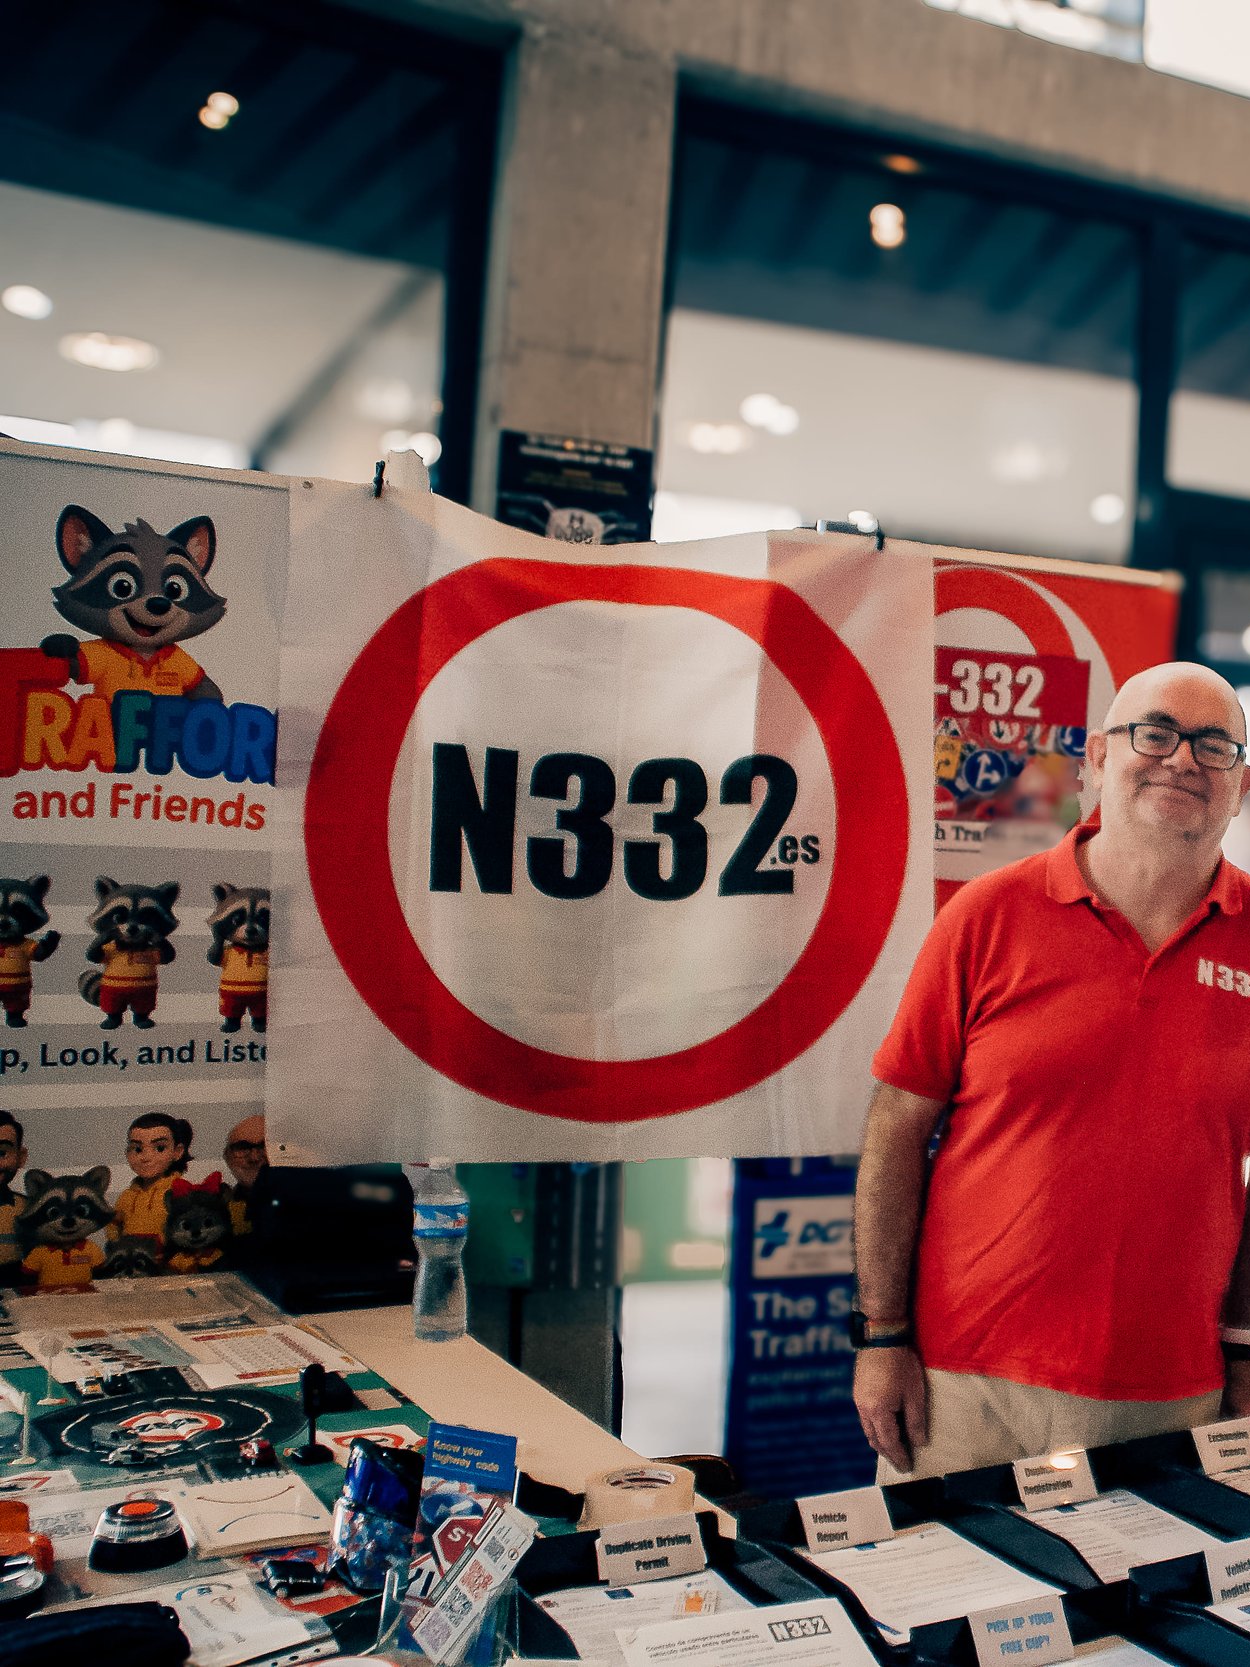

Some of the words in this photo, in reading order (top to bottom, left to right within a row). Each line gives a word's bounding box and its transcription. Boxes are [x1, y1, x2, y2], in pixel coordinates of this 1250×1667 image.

[12, 781, 96, 820] and
[110, 782, 267, 832] Friends
[40, 1040, 129, 1071] Look,
[136, 1039, 196, 1065] and
[798, 1219, 855, 1245] DG
[751, 1291, 817, 1321] The
[434, 1440, 460, 1453] Know
[463, 1446, 484, 1457] your
[432, 1452, 471, 1468] highway
[812, 1512, 848, 1523] Vehicle
[605, 1539, 654, 1555] Duplicate
[656, 1534, 693, 1549] Driving
[816, 1531, 848, 1543] Report
[635, 1556, 670, 1572] Permit
[770, 1616, 830, 1641] N332
[986, 1619, 1009, 1633] PICK
[1012, 1616, 1025, 1629] UP
[1028, 1611, 1055, 1625] YOUR
